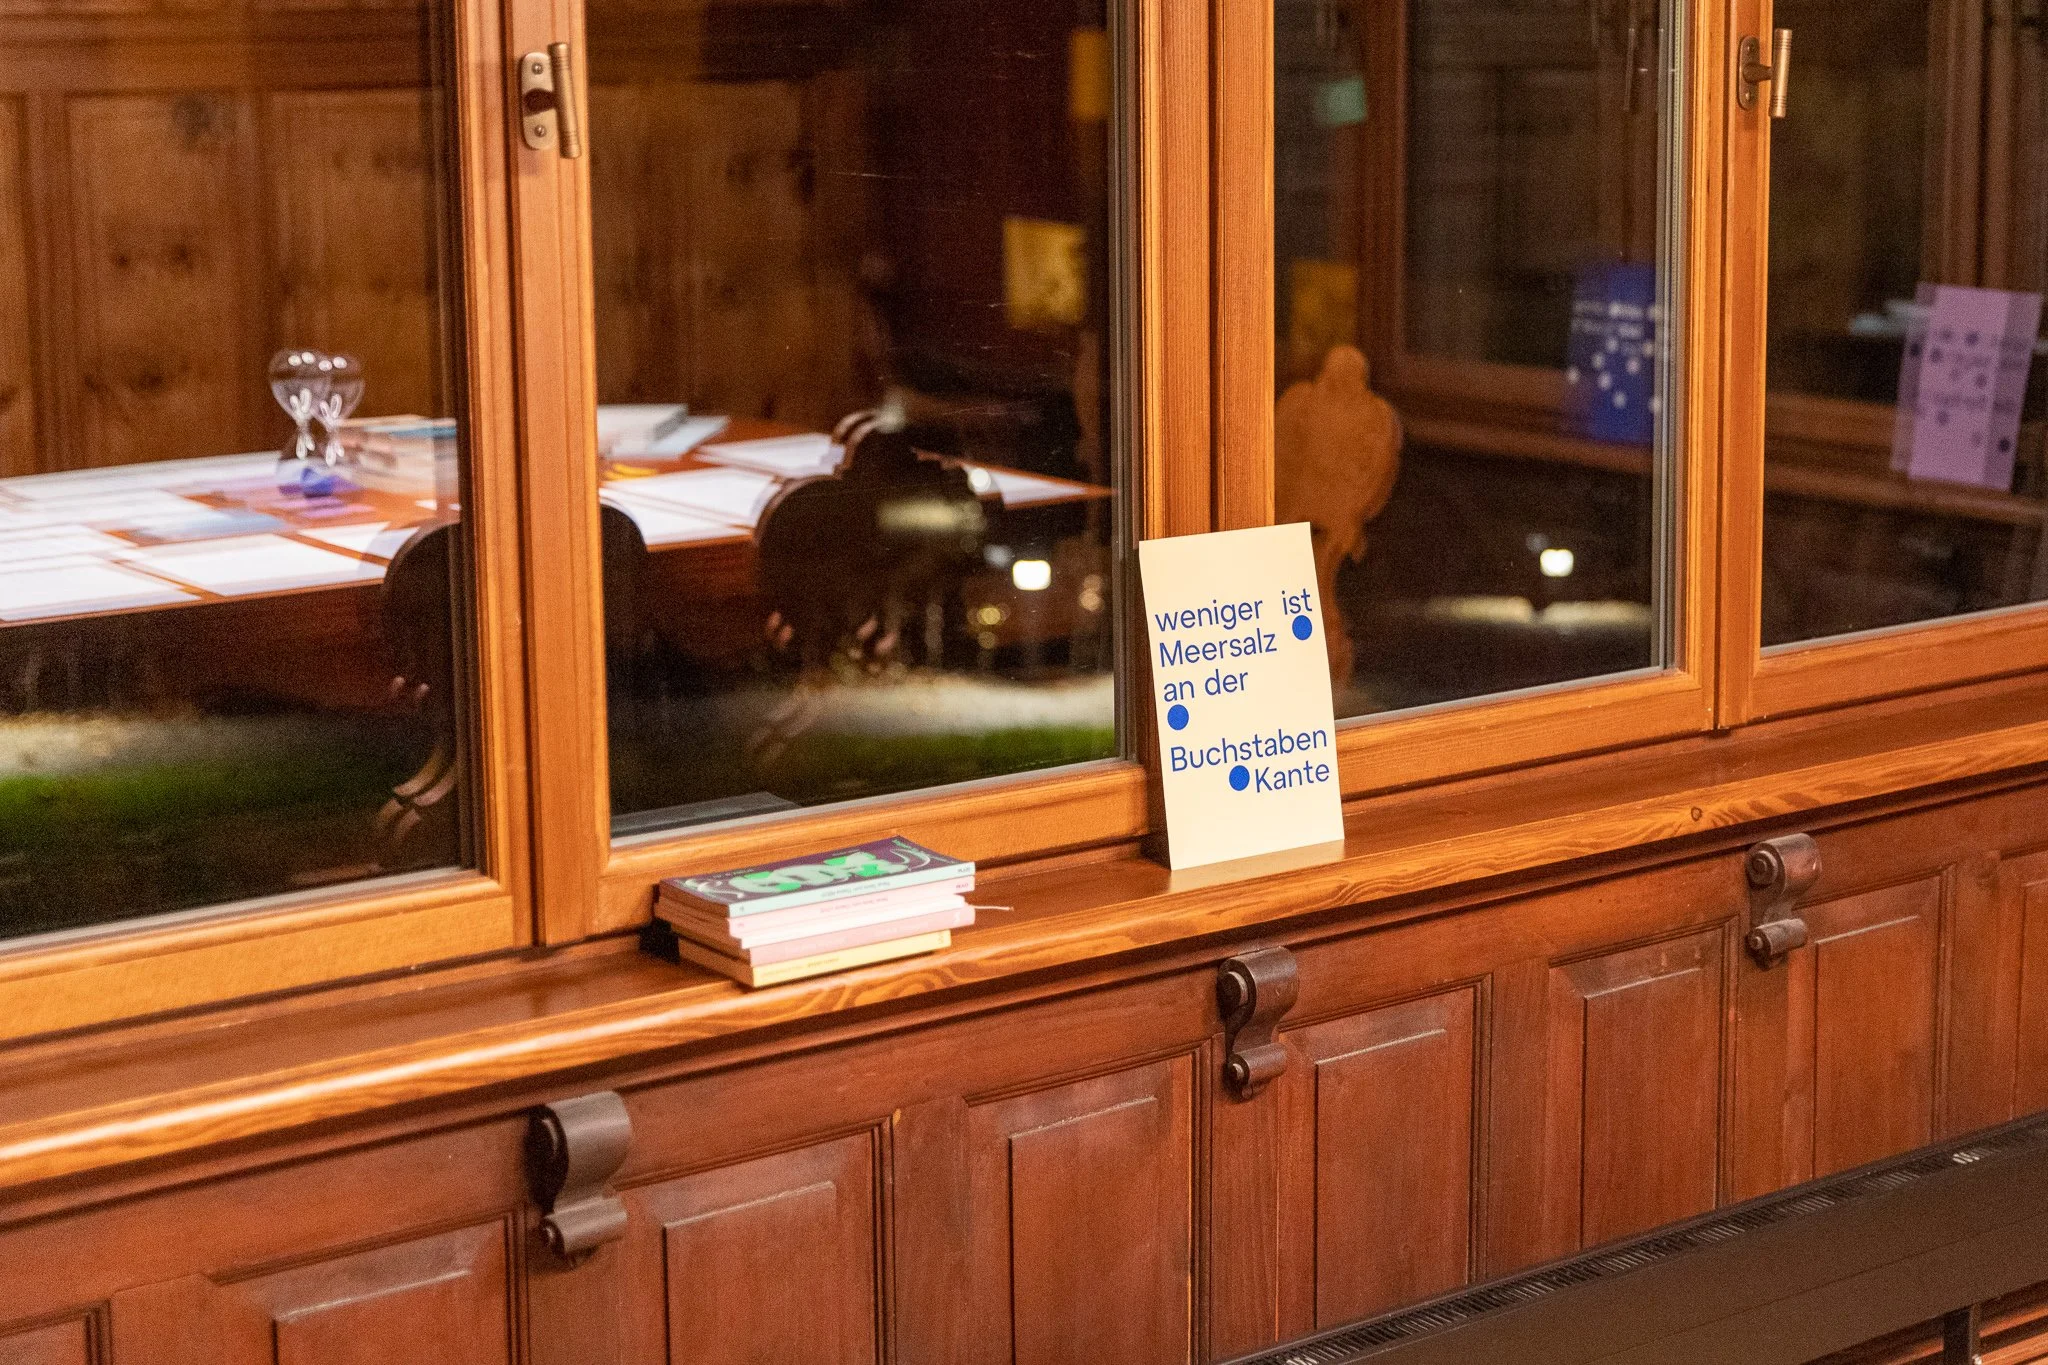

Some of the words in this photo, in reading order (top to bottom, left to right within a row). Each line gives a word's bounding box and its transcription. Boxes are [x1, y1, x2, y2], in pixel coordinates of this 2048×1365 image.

[1155, 599, 1263, 632] weniger
[1282, 589, 1313, 616] ist
[1160, 627, 1278, 668] Meersalz
[1163, 680, 1195, 703] an
[1204, 668, 1249, 696] der
[1170, 728, 1328, 772] Buchstaben
[1255, 760, 1331, 794] Kante
